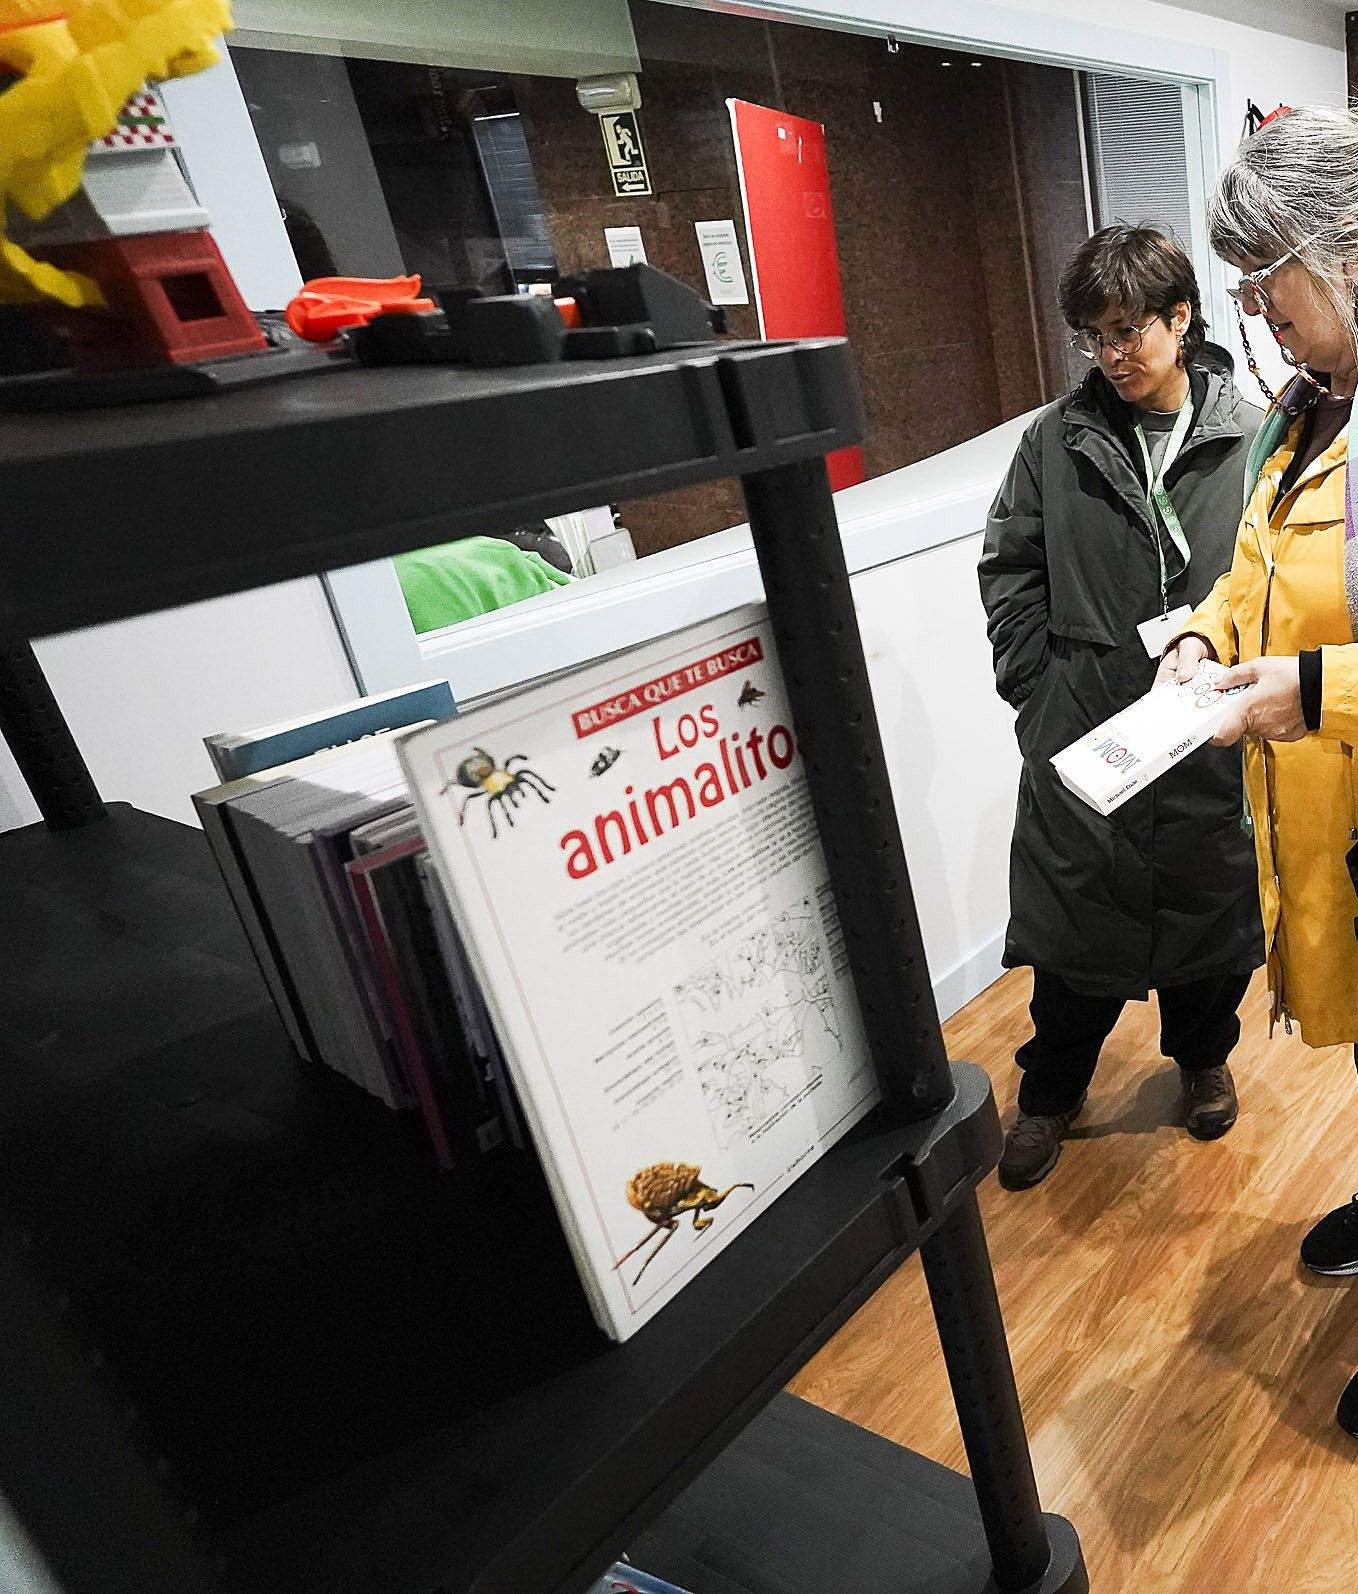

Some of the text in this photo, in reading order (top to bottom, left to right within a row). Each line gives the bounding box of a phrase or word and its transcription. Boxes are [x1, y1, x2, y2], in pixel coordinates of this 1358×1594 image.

[616, 171, 645, 183] SALIDA
[577, 686, 643, 729] BUSCA
[643, 676, 683, 708] QUE
[706, 643, 761, 681] BUSCA
[651, 703, 720, 761] Los
[1088, 735, 1142, 775] MOM
[558, 723, 796, 880] animalito
